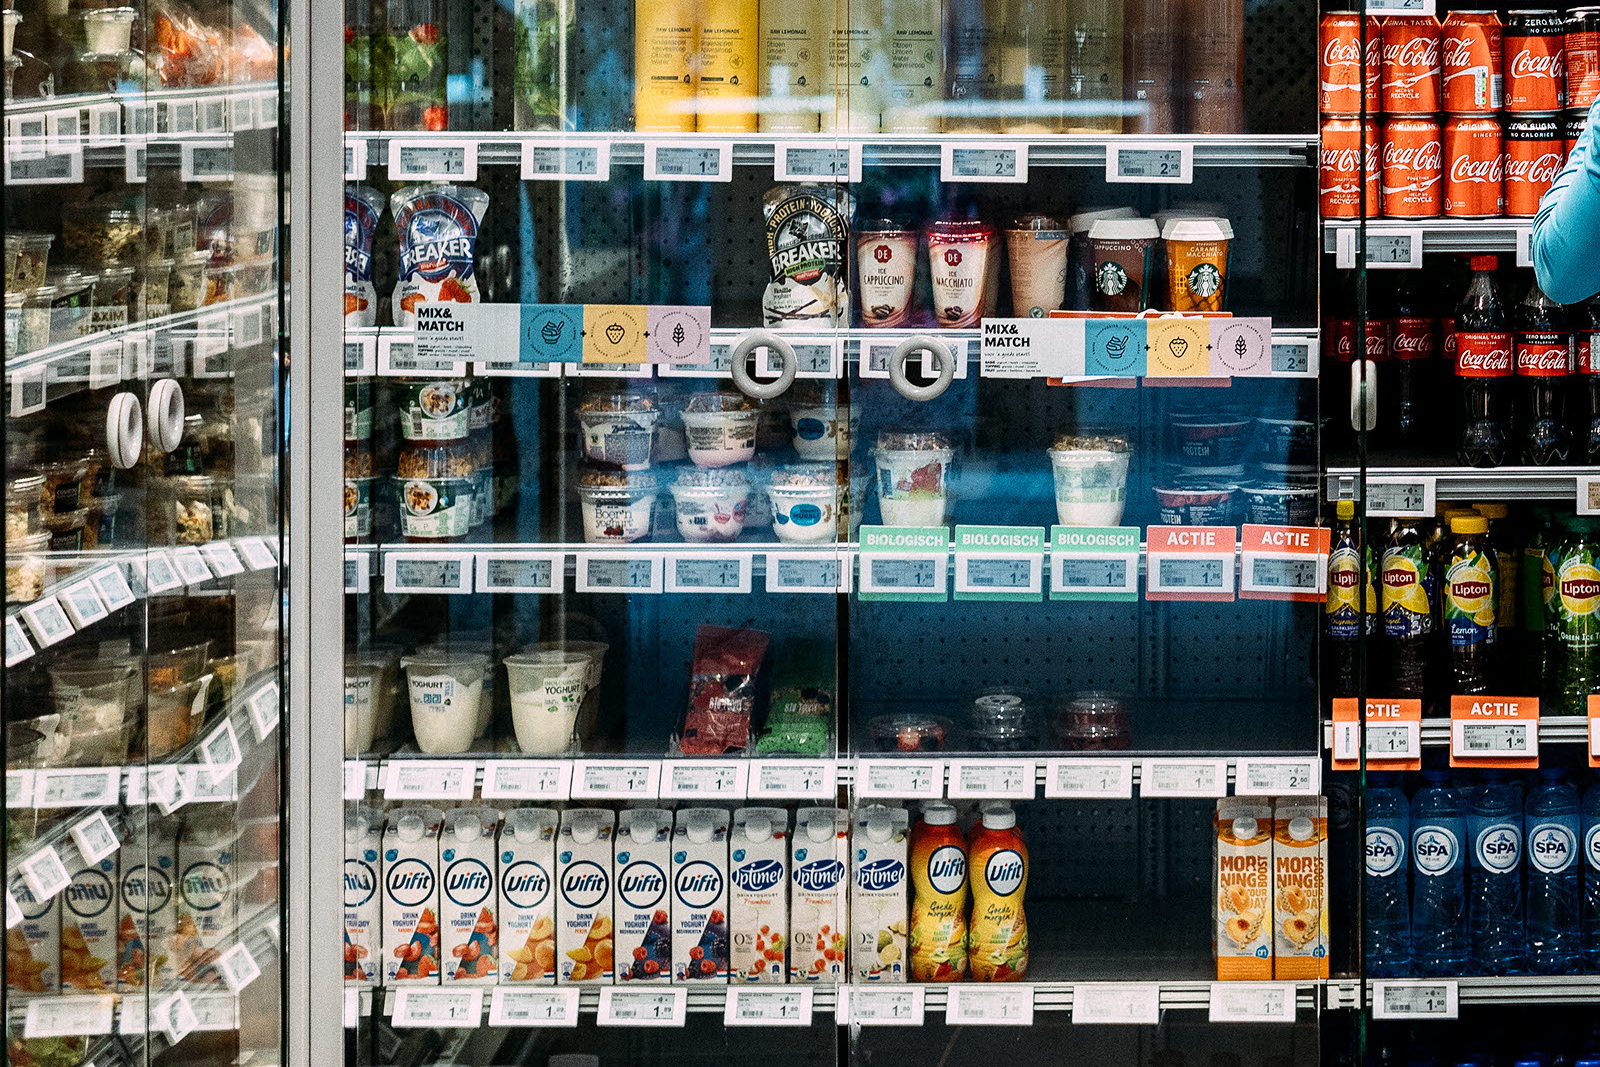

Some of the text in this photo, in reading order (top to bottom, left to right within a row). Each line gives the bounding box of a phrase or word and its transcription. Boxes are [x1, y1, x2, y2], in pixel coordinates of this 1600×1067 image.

[771, 240, 842, 273] BREAKER
[864, 274, 904, 286] CAPPUCCINO
[418, 308, 452, 319] MIX&
[418, 321, 464, 332] MATCH
[985, 325, 1018, 335] MIX&
[985, 337, 1030, 347] MATCH
[1459, 349, 1510, 370] Coca-Cola
[1518, 349, 1567, 370] Coca-Cola
[867, 534, 943, 547] BIOLOGISCH
[962, 534, 1039, 546] BIOLOGISCH
[1058, 533, 1135, 546] BIOLOGISCH
[1166, 531, 1216, 546] ACTIE
[1261, 531, 1310, 546] ACTIE
[1384, 572, 1413, 583] Lipton
[1455, 583, 1488, 597] Lipton
[1563, 582, 1600, 595] Lipton
[412, 681, 443, 689] YOGHURT
[544, 684, 580, 695] YOGHURT
[1470, 703, 1519, 717] ACTIE
[1418, 844, 1448, 858] SPA
[1486, 842, 1517, 855] SPA
[1536, 842, 1567, 855] SPA
[932, 858, 965, 877] Vifit
[1220, 856, 1257, 872] MOR
[1277, 856, 1314, 872] MOR
[990, 862, 1021, 882] Vifit
[392, 872, 430, 890] Vifit
[450, 872, 487, 890] Vifit
[507, 874, 546, 892] Vifit
[566, 874, 604, 892] Vifit
[623, 874, 662, 893] Vifit
[680, 874, 719, 893] Vifit
[1220, 873, 1257, 888] NING
[1277, 873, 1314, 888] NING
